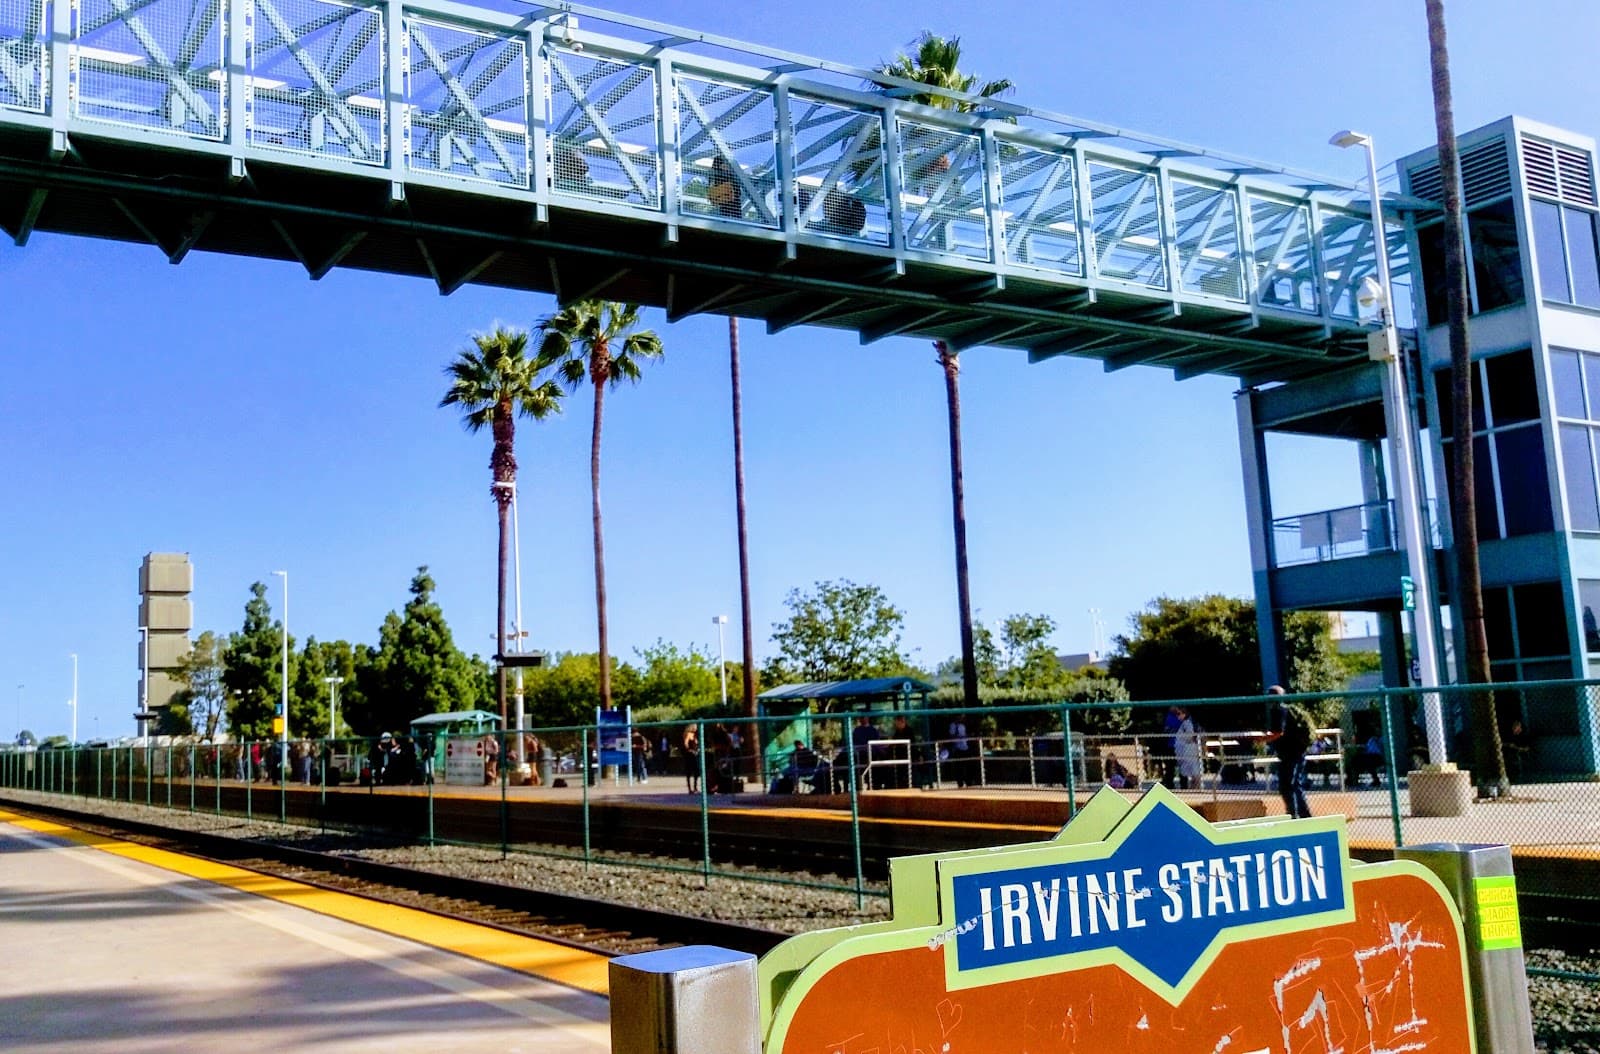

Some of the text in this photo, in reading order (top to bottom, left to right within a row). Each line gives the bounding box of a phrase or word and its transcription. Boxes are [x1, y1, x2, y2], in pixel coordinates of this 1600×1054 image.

[1406, 591, 1414, 608] 2
[980, 845, 1328, 951] IRVINE STATION
